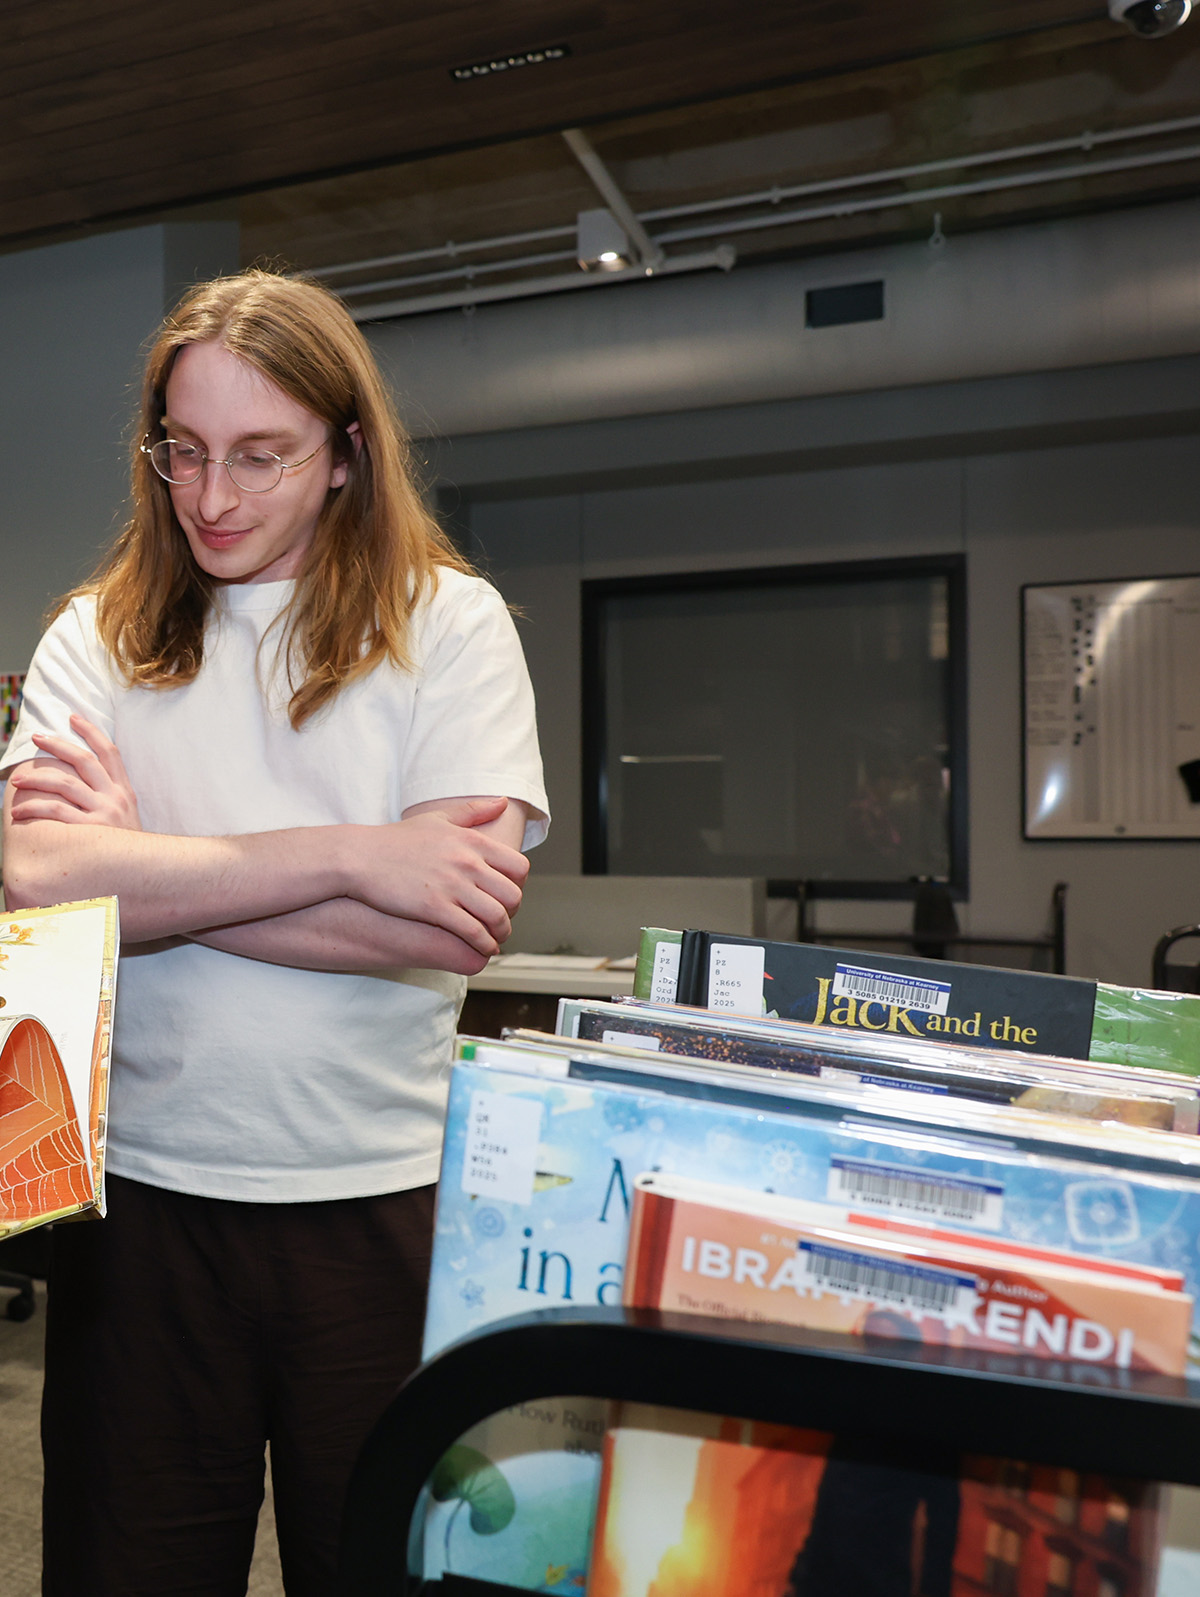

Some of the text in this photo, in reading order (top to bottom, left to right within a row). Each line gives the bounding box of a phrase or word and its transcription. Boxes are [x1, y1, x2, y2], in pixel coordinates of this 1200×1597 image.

[660, 957, 670, 965] PZ
[716, 979, 741, 988] .R665
[846, 968, 874, 981] University
[882, 975, 908, 985] Nebraska
[916, 981, 939, 991] Kearney
[656, 986, 672, 995] Ord
[714, 999, 735, 1007] 2025
[855, 991, 877, 1000] 5085
[879, 995, 906, 1006] 01219
[909, 1000, 931, 1010] 2639
[926, 1012, 981, 1037] and
[990, 1016, 1038, 1045] the
[517, 1227, 572, 1300] in
